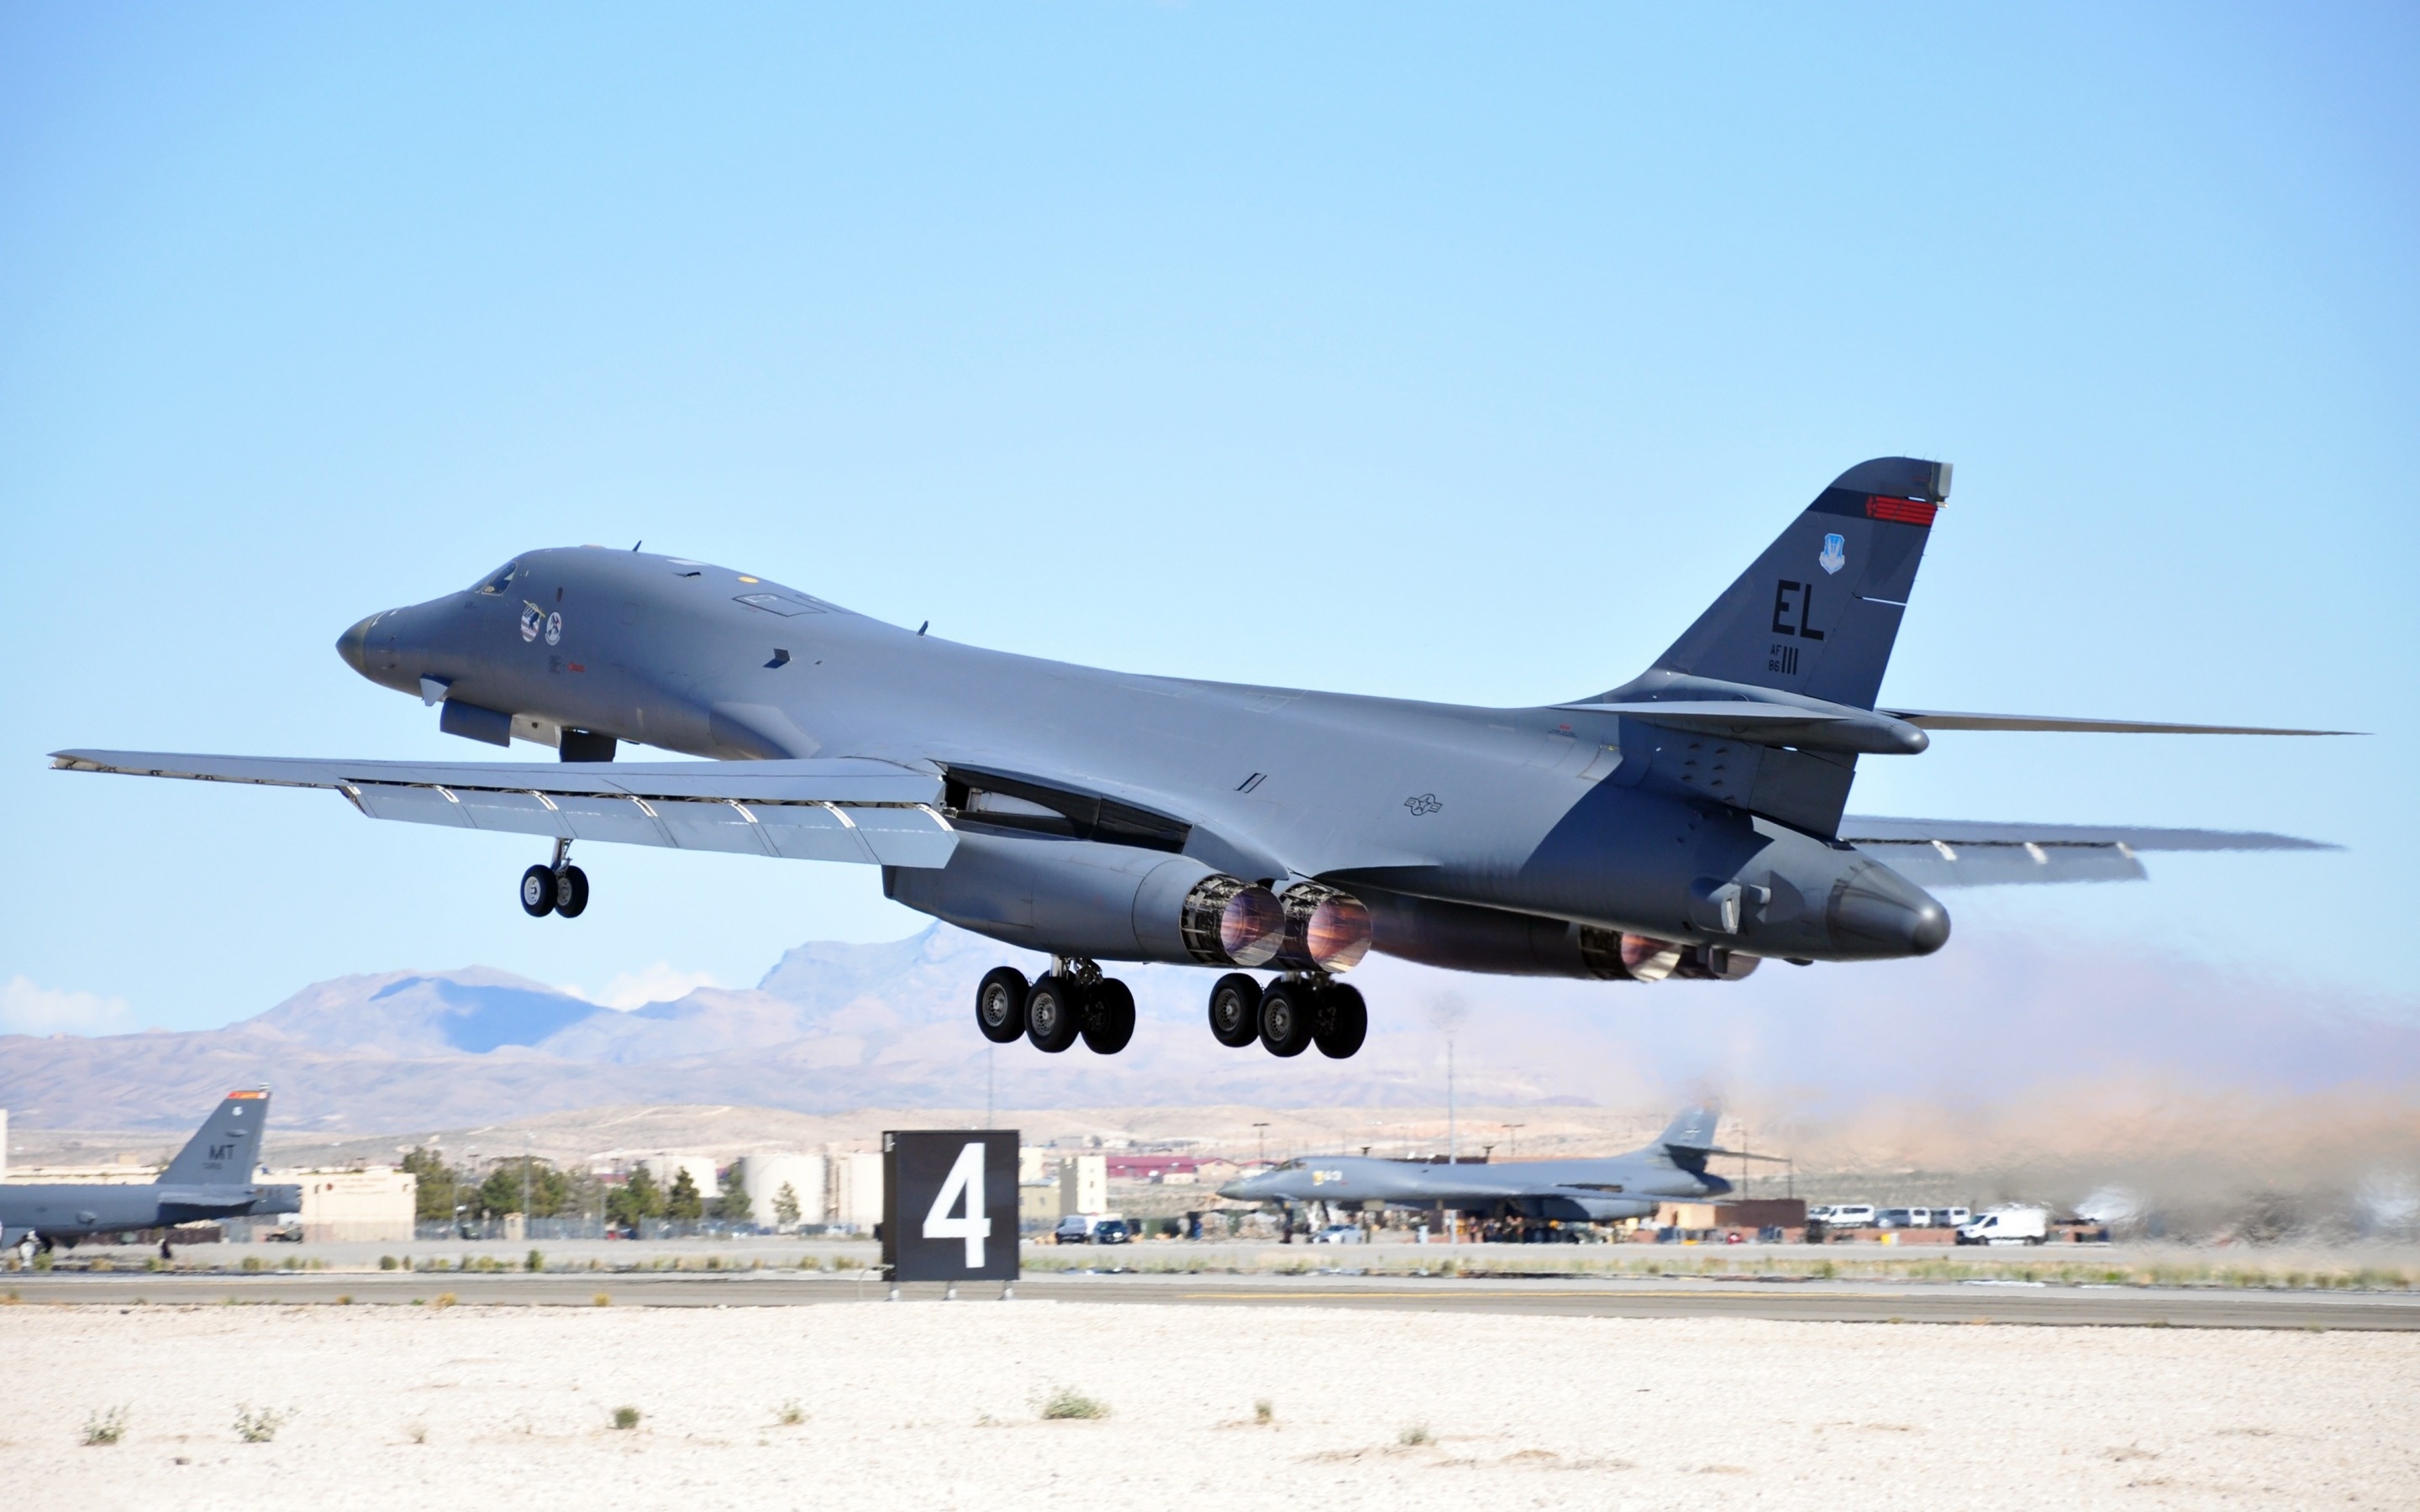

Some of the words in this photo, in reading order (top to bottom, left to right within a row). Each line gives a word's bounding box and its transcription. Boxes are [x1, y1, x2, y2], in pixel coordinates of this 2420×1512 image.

[1772, 579, 1824, 641] EL
[1770, 644, 1781, 655] AF
[1769, 659, 1780, 671] 86
[208, 1144, 234, 1160] MT
[923, 1142, 991, 1268] 4
